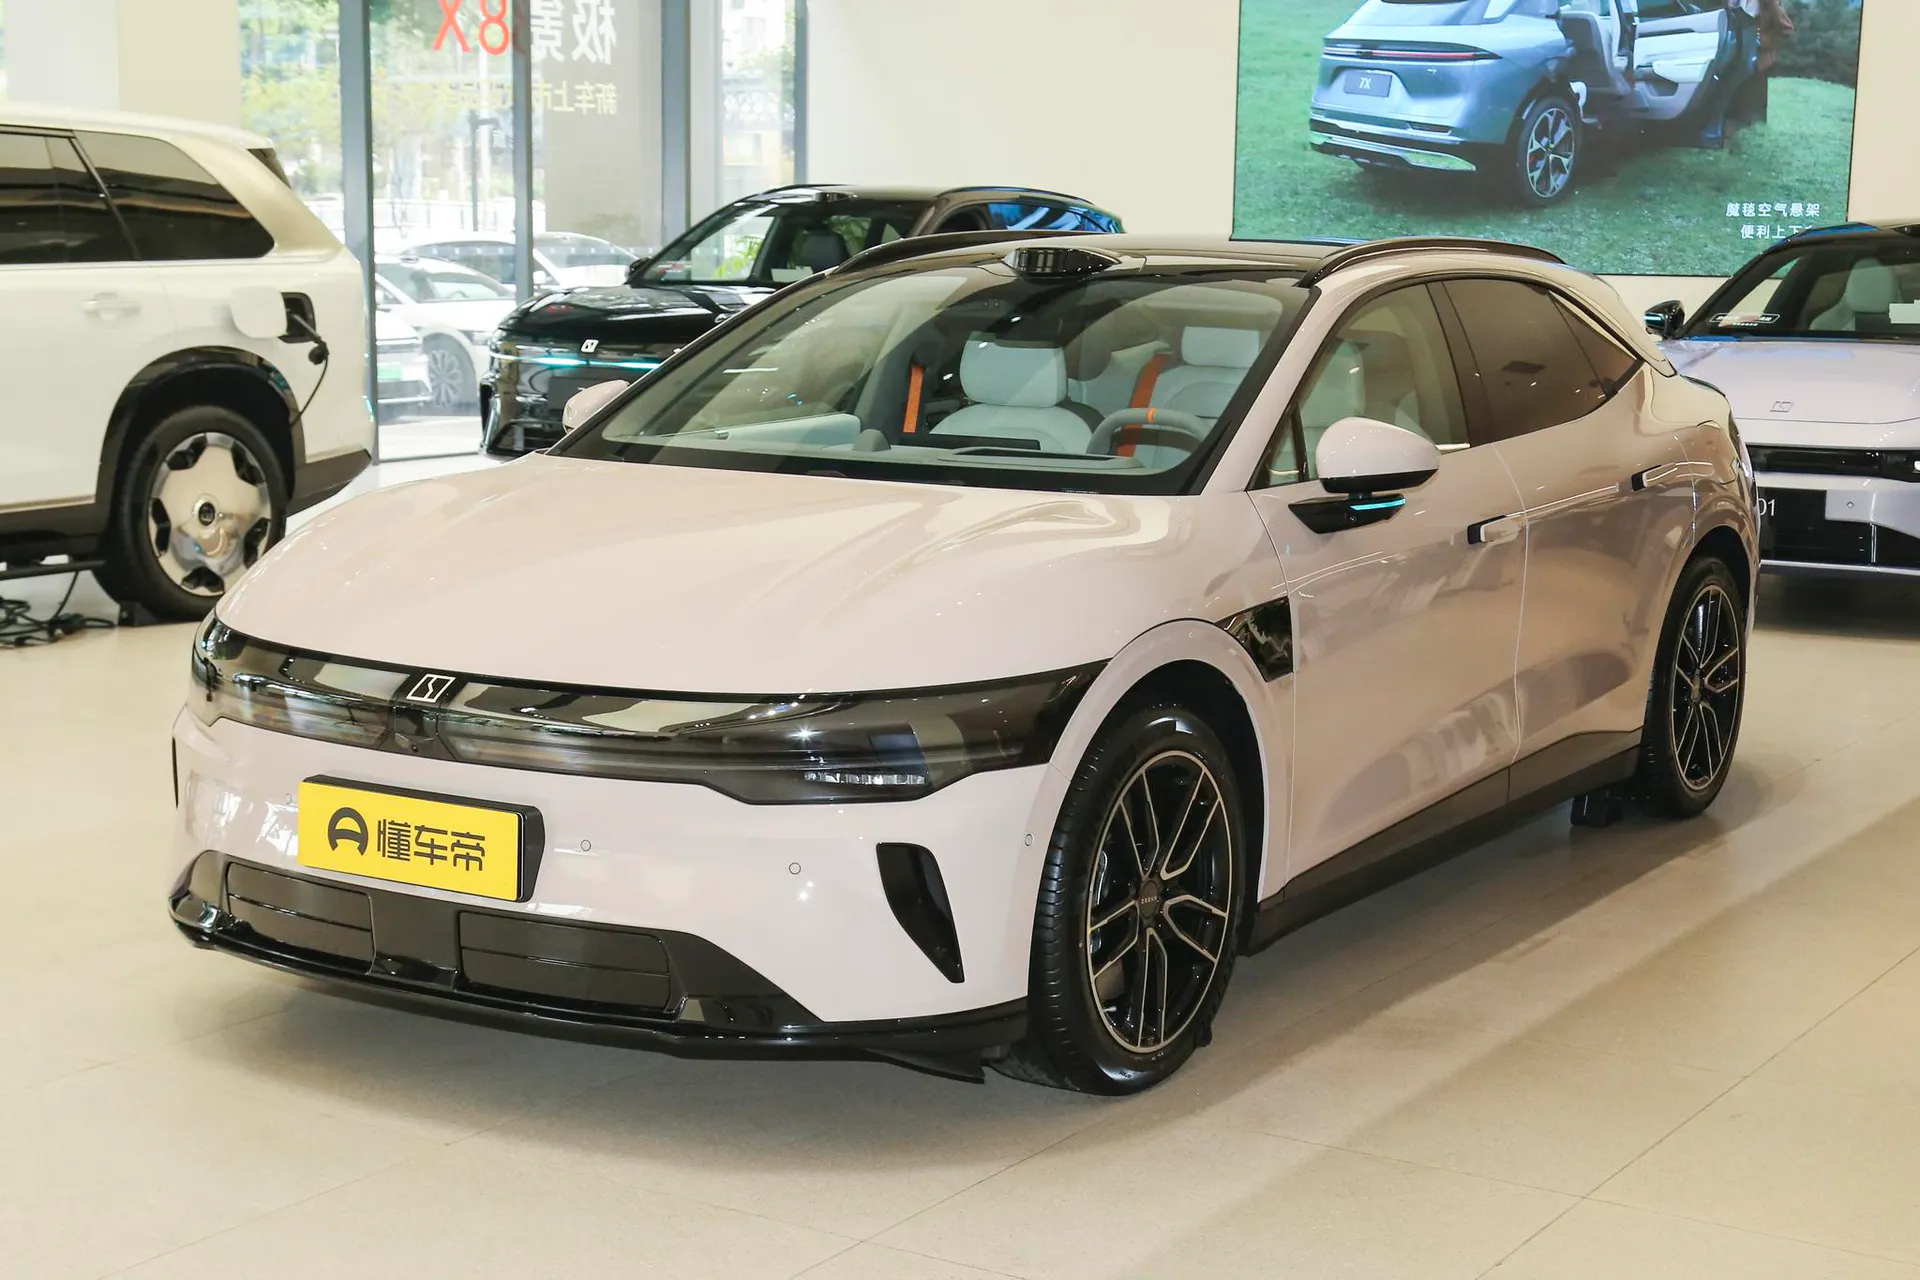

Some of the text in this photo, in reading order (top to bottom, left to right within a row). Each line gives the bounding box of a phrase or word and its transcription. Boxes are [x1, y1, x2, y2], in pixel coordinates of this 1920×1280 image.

[1359, 77, 1372, 89] 7X
[1725, 202, 1820, 217] 魔毯空气悬架
[1740, 224, 1813, 239] 便利上下
[377, 818, 486, 872] 懂车帝
